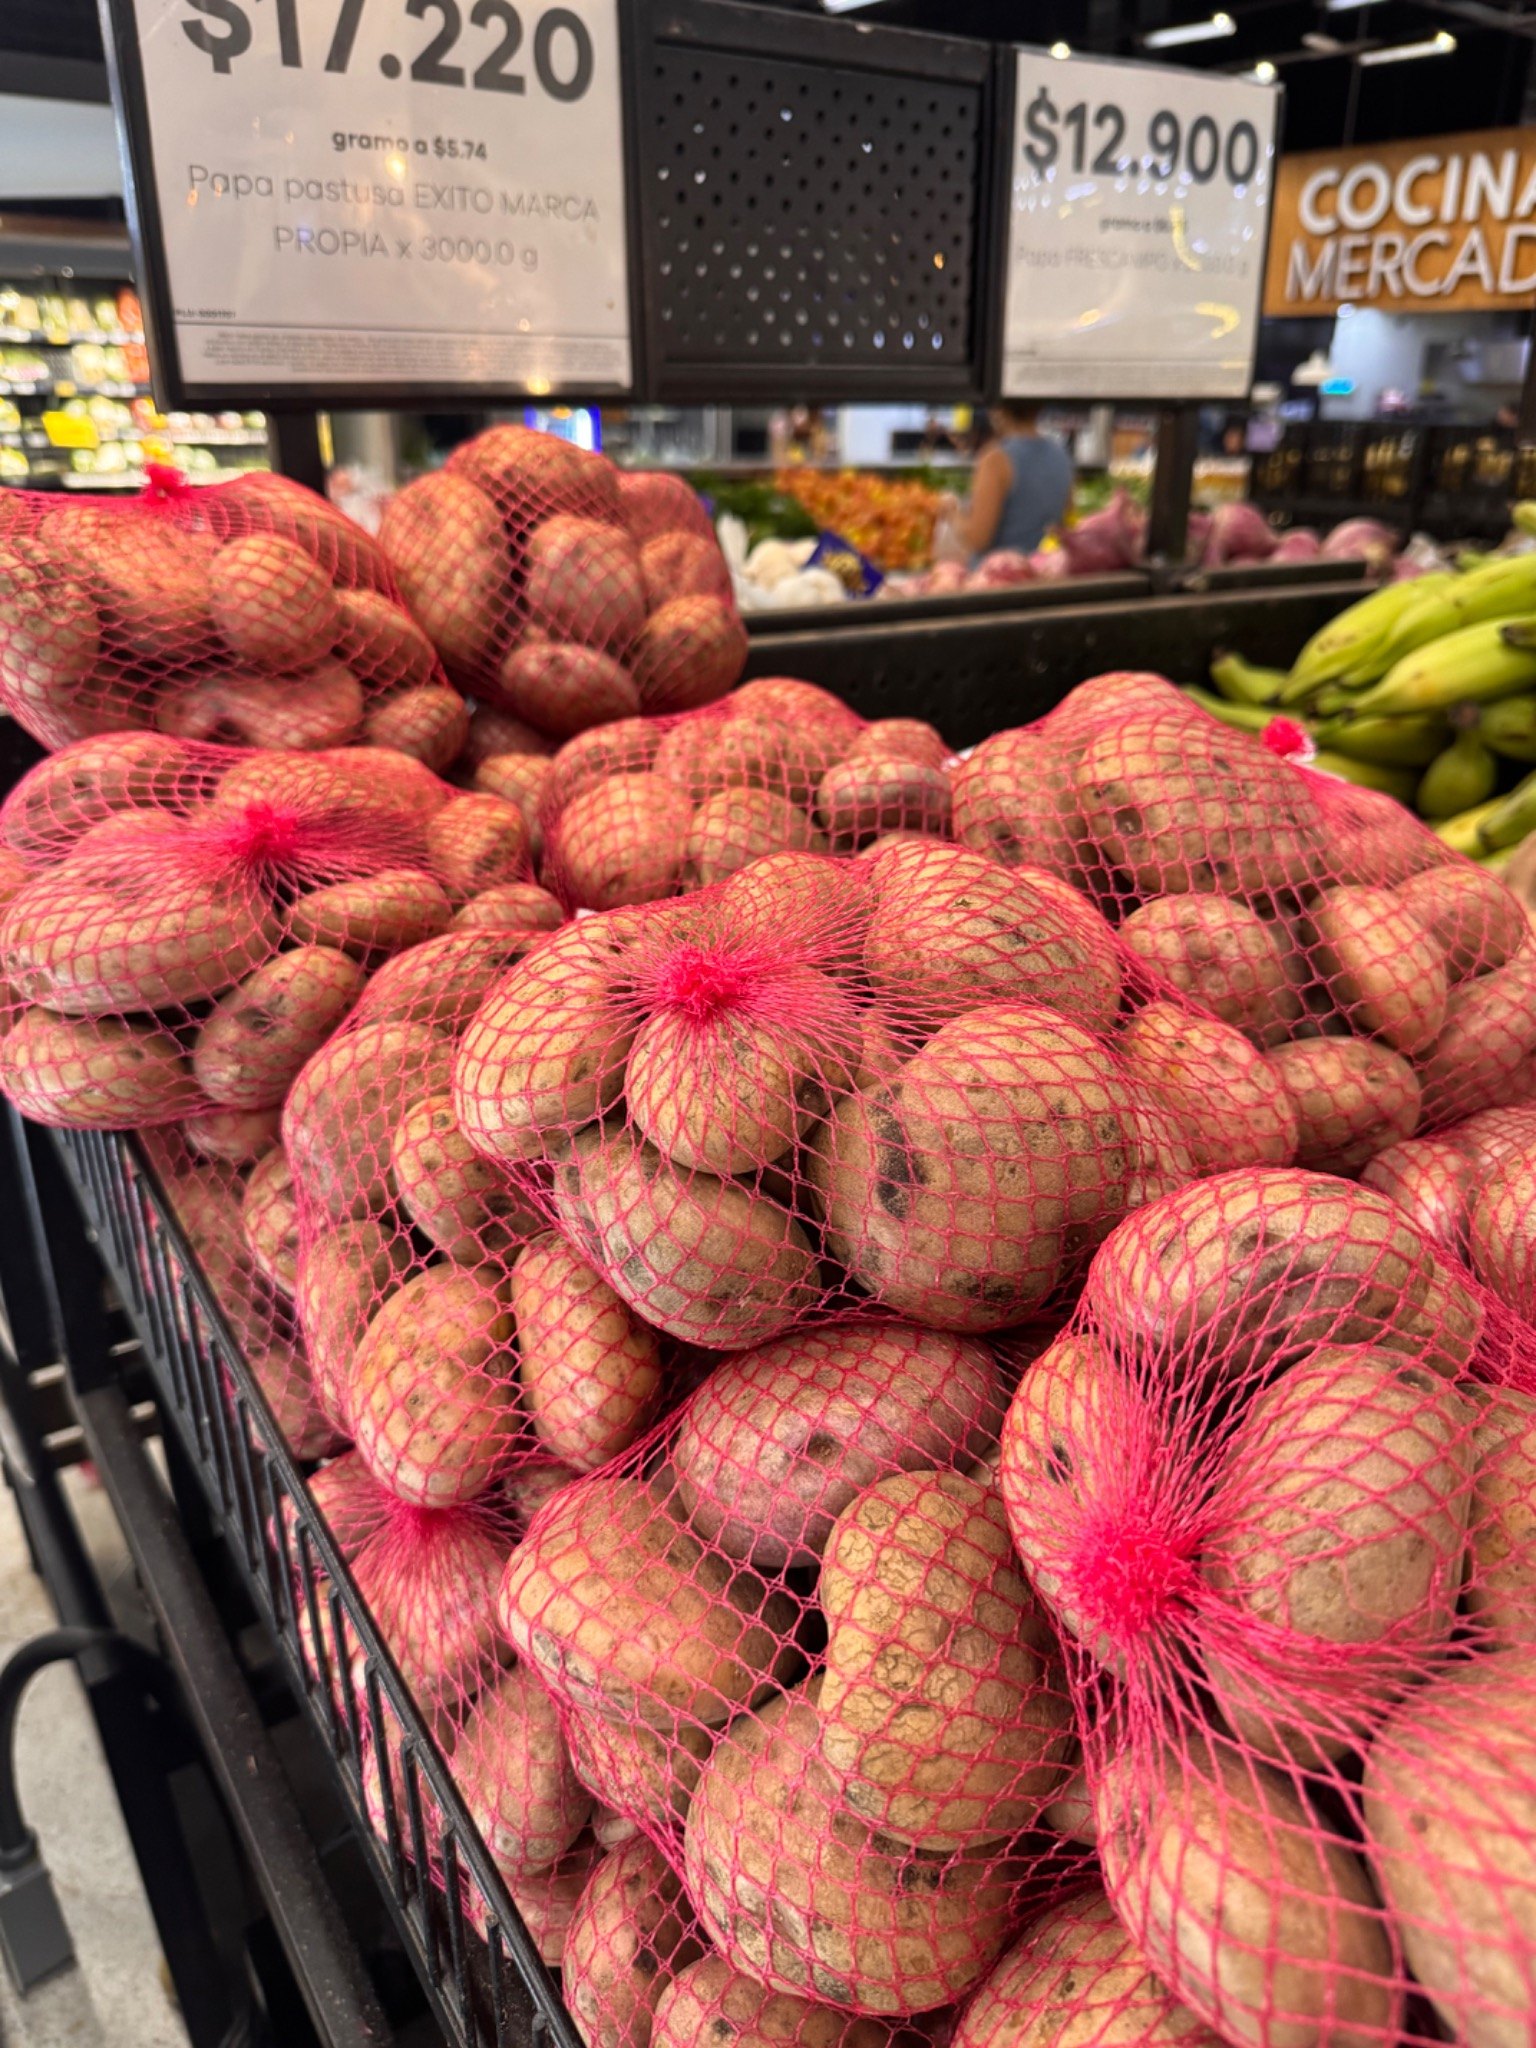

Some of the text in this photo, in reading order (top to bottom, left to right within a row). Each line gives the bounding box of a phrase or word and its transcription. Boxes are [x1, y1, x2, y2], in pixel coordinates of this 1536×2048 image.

[181, 0, 595, 103] $17.220
[332, 131, 487, 160] gramo a $5.74
[1022, 86, 1258, 187] $12.900
[188, 164, 599, 222] Papa pastusa EXITO MARCA
[274, 225, 389, 257] PROPIA
[1285, 223, 1536, 301] MERCAD
